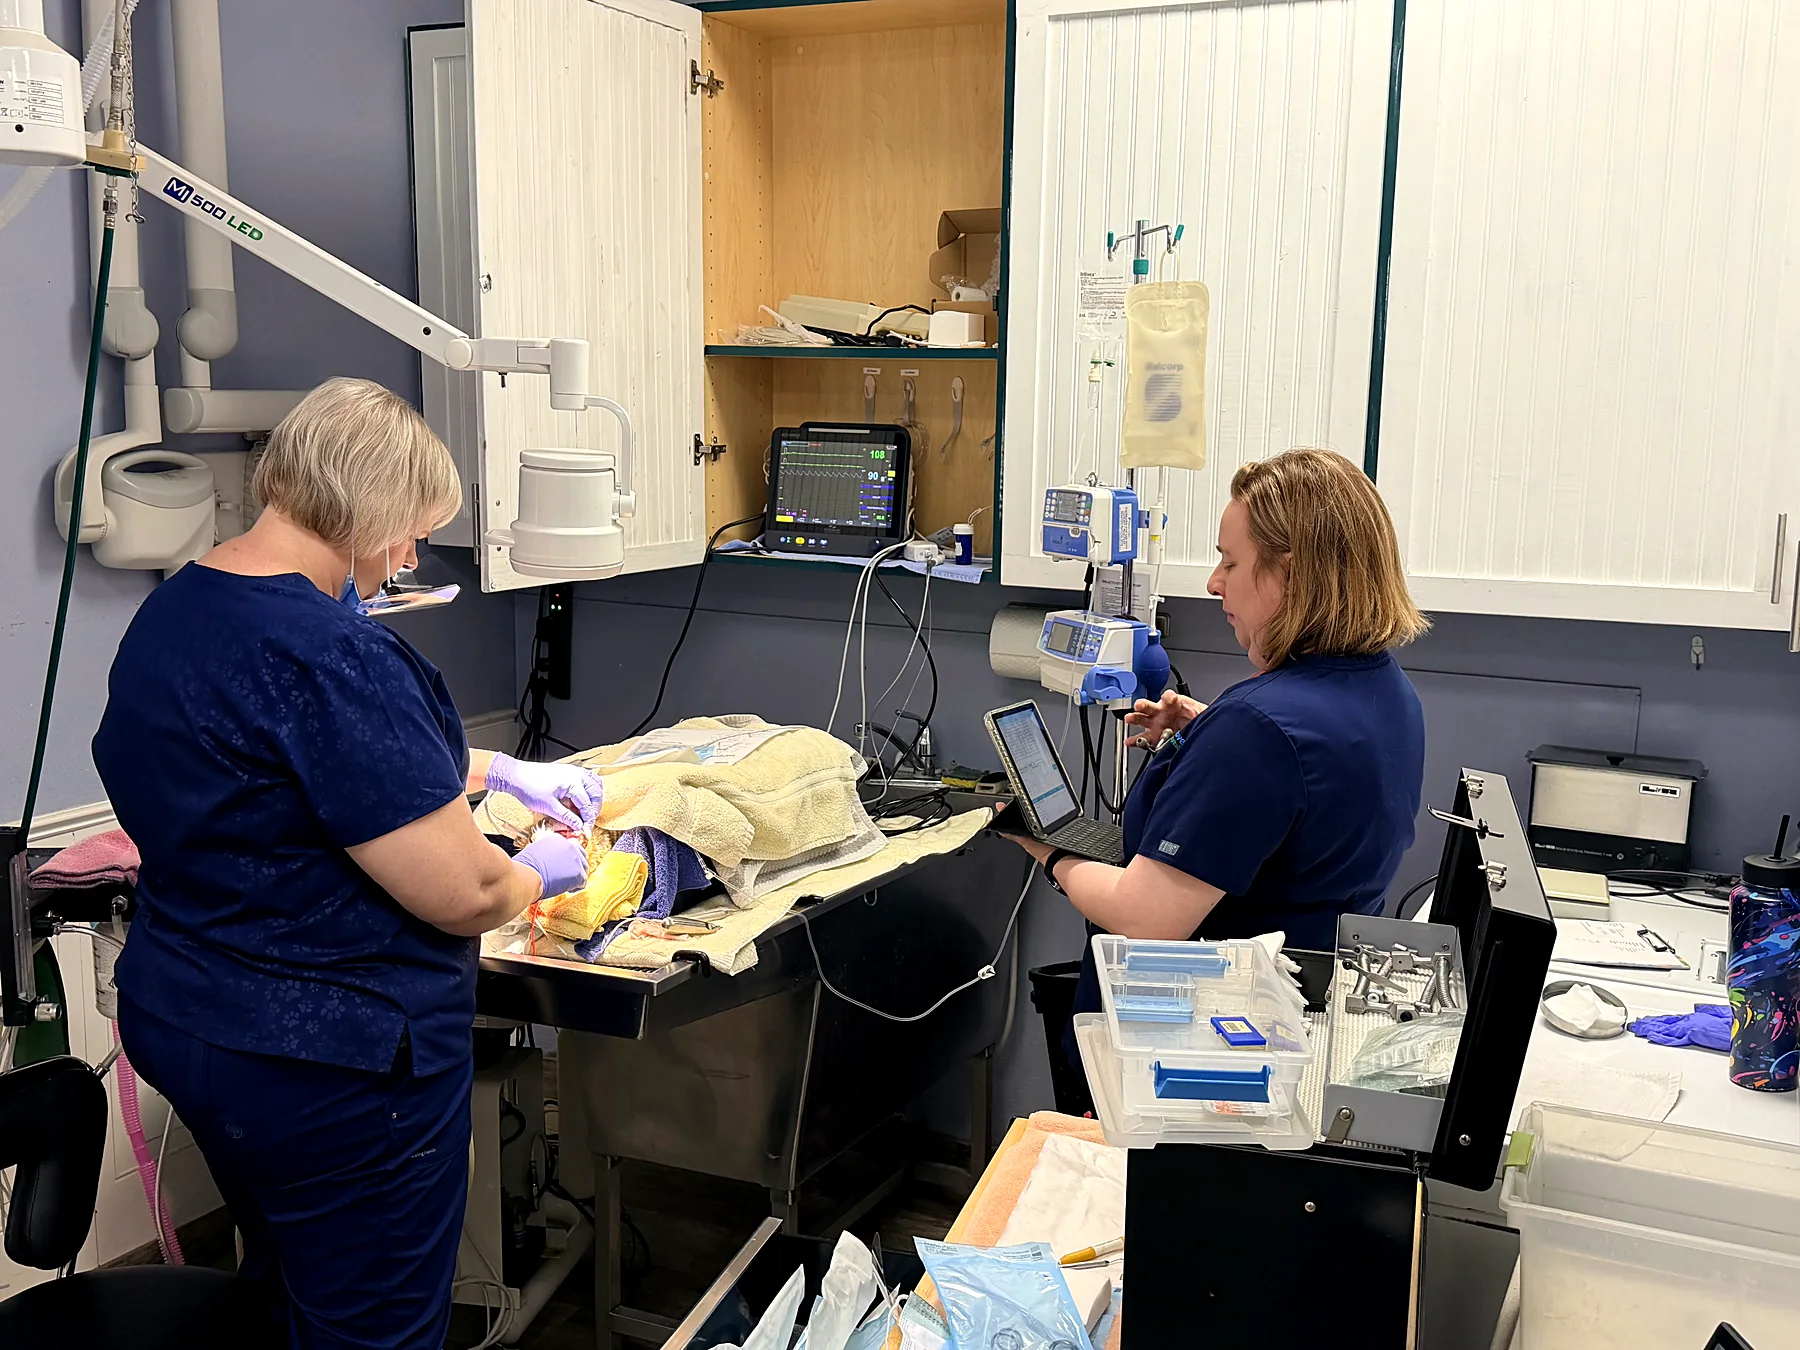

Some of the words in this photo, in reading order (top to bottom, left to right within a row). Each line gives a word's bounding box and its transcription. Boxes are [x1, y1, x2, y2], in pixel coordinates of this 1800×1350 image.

[190, 194, 227, 221] 500
[226, 215, 264, 241] LED
[870, 450, 885, 459] 108
[868, 471, 879, 481] 90
